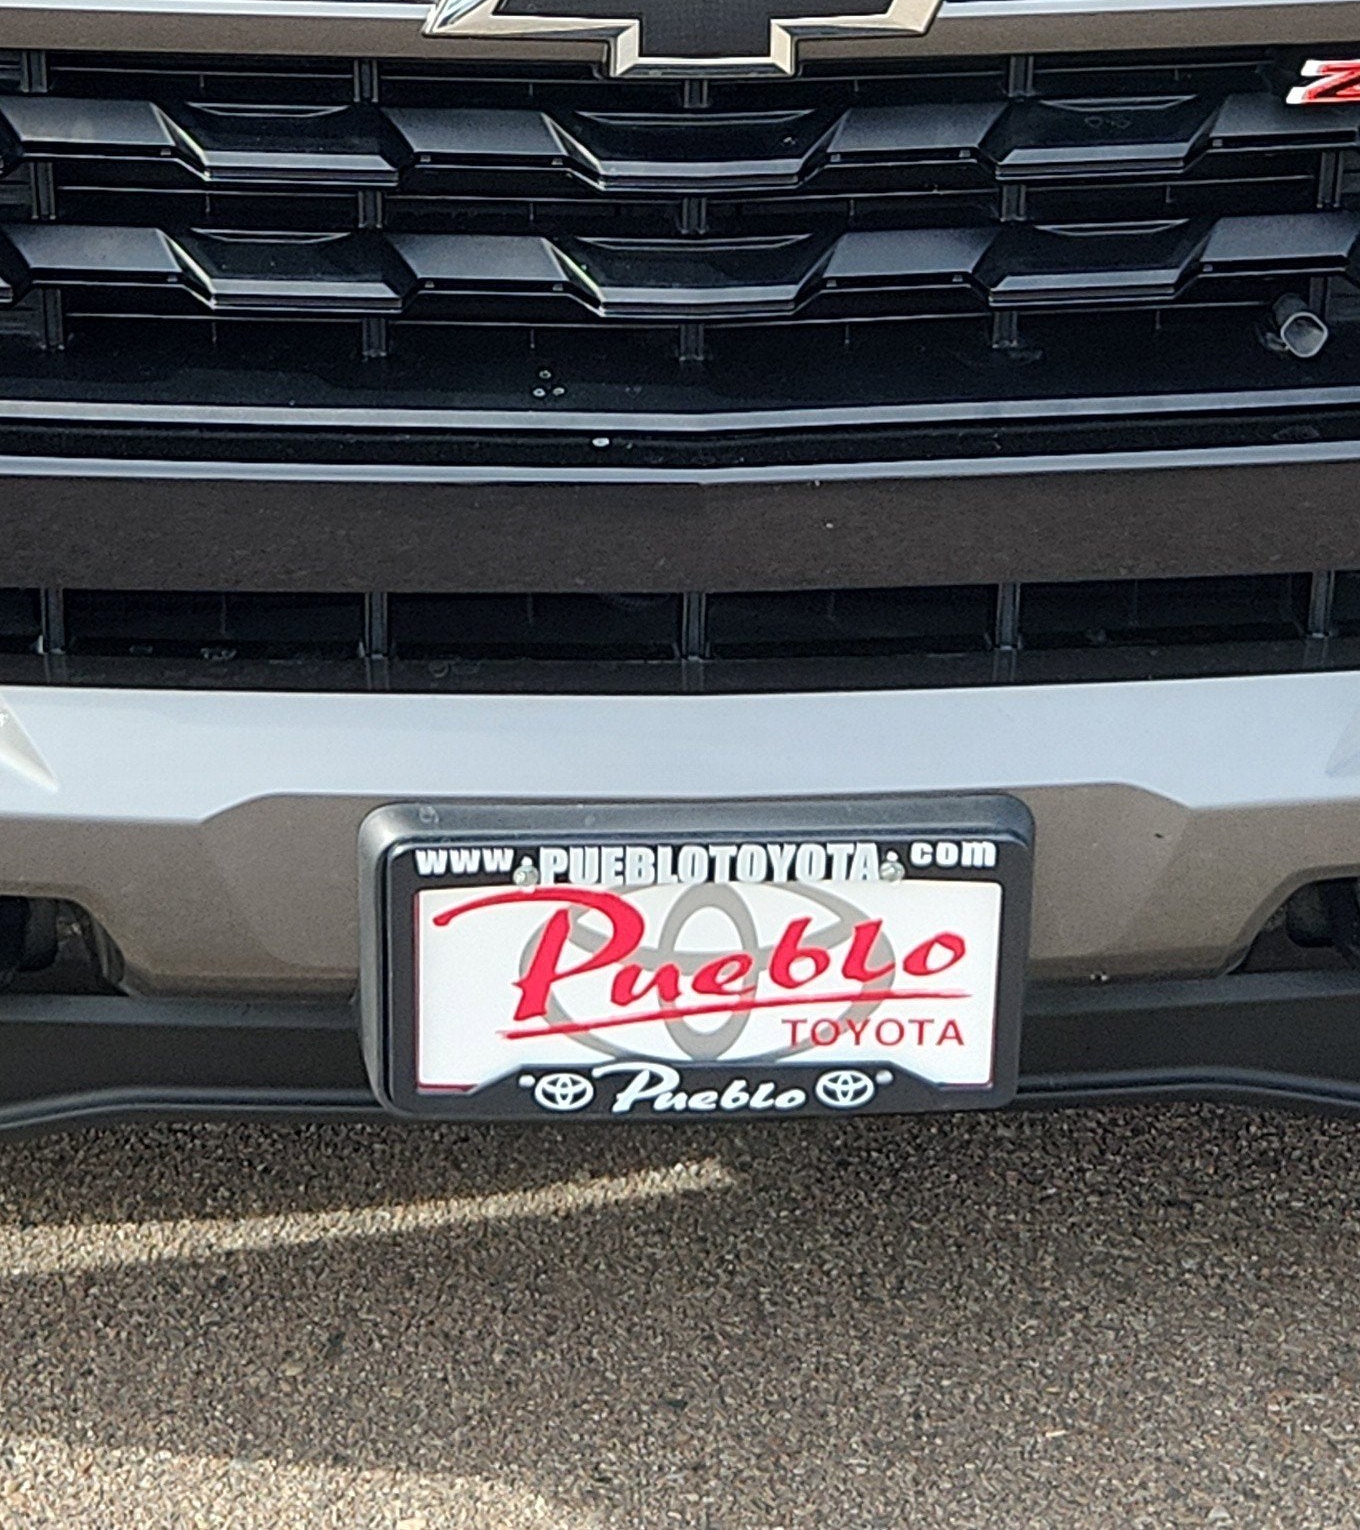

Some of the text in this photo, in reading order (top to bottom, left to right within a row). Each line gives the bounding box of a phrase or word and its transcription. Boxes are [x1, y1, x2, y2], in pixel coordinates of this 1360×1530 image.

[433, 888, 966, 1021] Pueblo
[782, 1017, 965, 1047] TOYOTA
[592, 1062, 807, 1113] Pueblo
